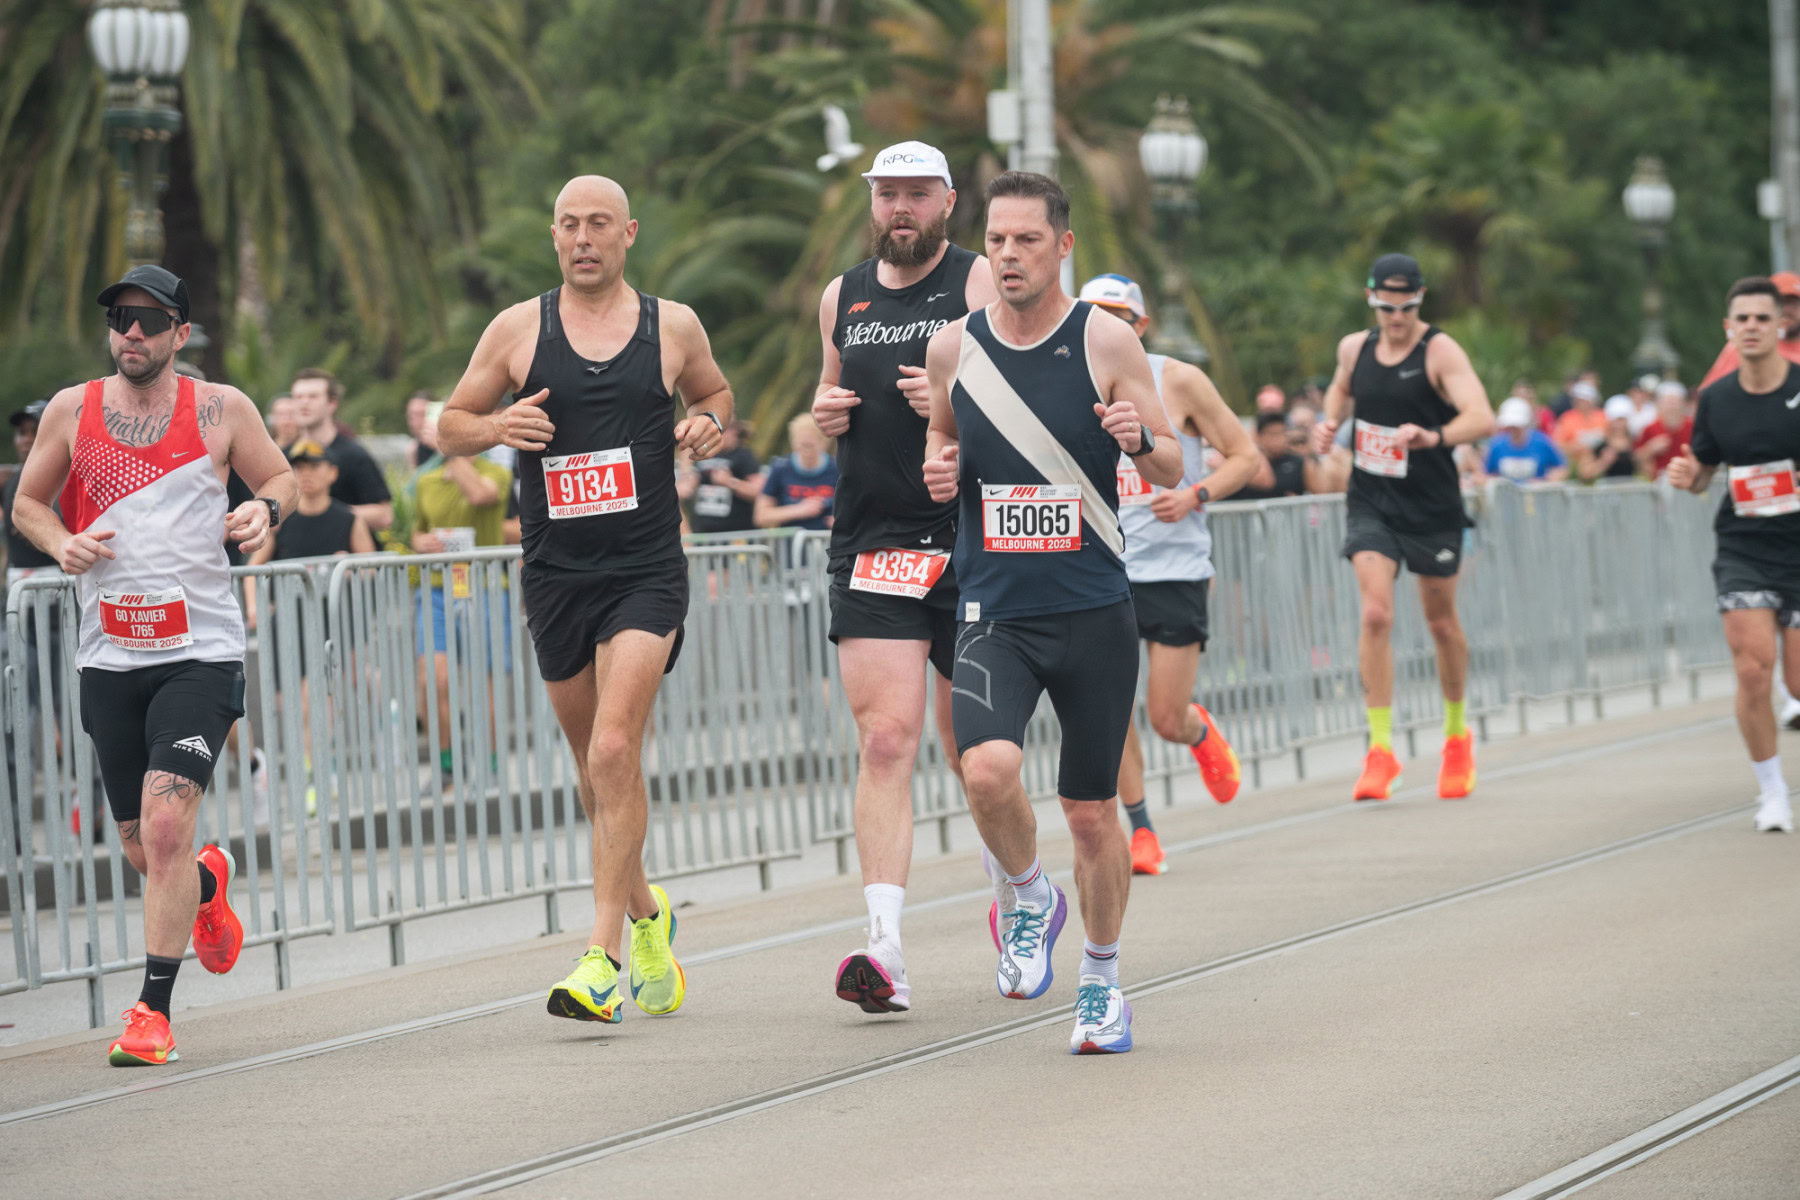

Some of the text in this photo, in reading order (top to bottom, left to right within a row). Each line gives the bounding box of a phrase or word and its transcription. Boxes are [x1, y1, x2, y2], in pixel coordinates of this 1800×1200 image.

[883, 153, 914, 166] RPG
[844, 318, 948, 349] Melbourne
[559, 466, 618, 504] 9134
[556, 499, 628, 517] MELBOURNE 2025
[995, 504, 1070, 536] 15065
[991, 538, 1072, 549] MELBOURNE 2025
[870, 550, 931, 584] 9354
[858, 580, 909, 593] MELBOURNE
[115, 608, 167, 623] GO XAVIER
[130, 624, 155, 637] 1765
[109, 635, 183, 648] MELBOURNE 2025
[172, 743, 193, 752] NIKE
